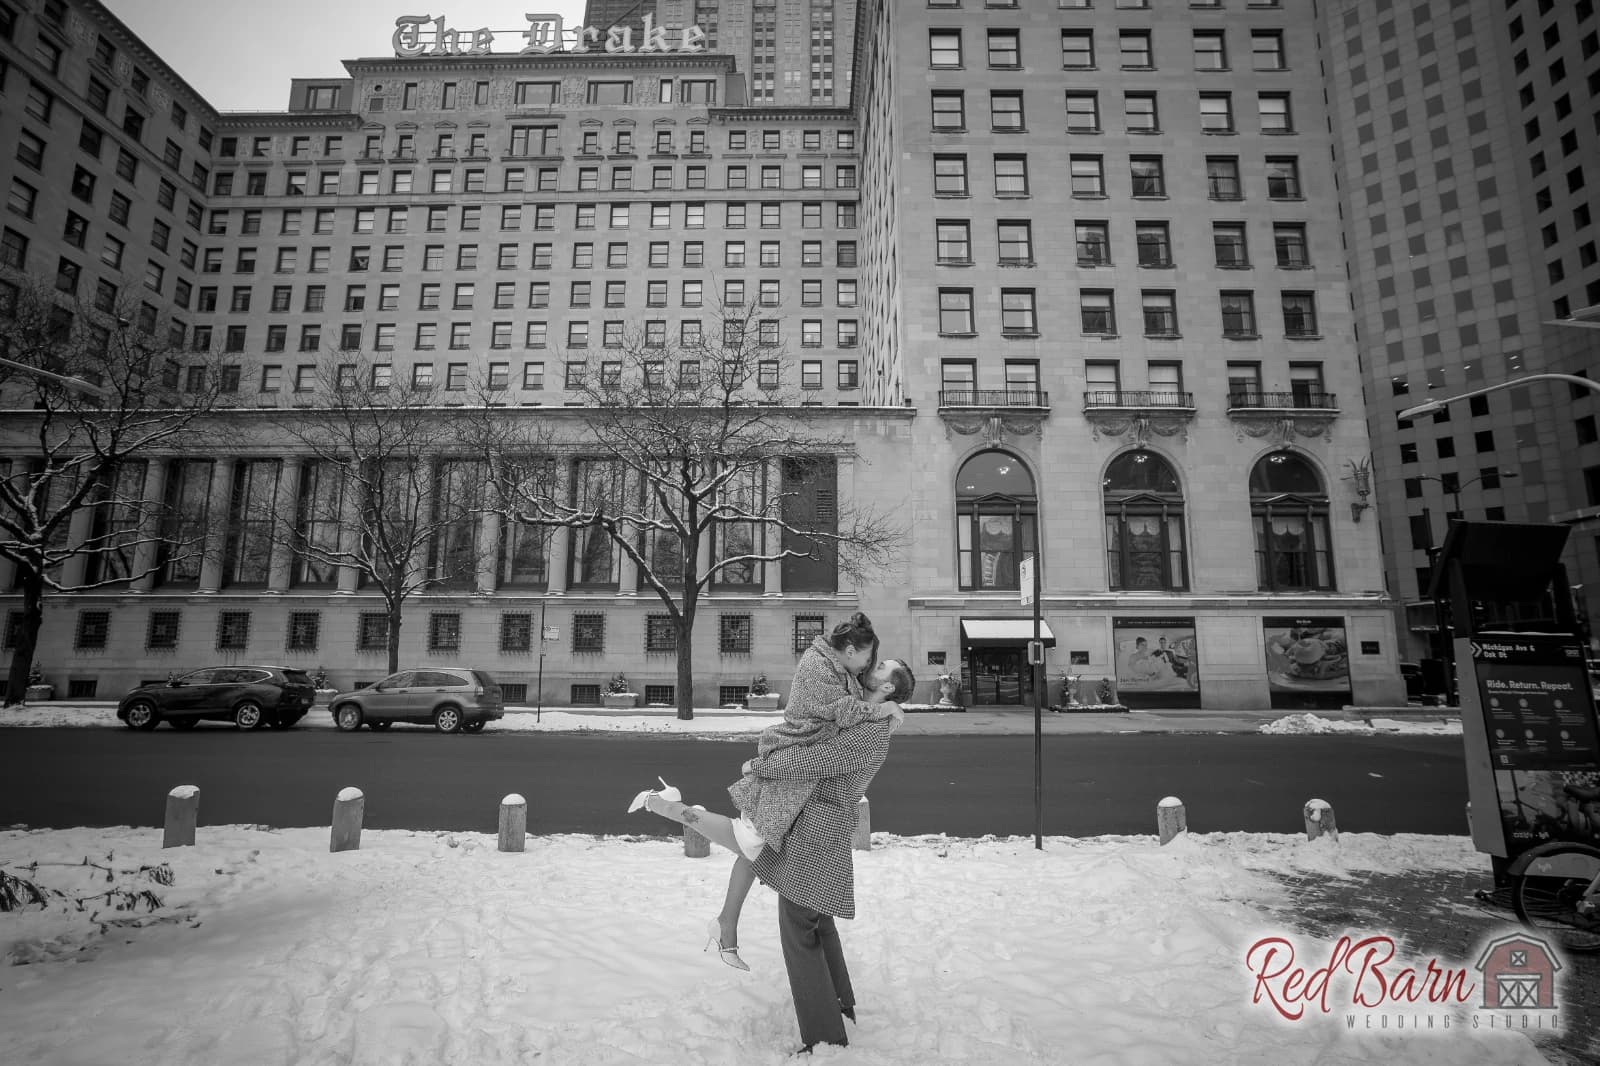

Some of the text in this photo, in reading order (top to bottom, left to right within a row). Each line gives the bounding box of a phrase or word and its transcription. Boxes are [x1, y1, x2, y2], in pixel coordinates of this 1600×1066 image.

[392, 12, 706, 57] The Drake
[1482, 643, 1513, 652] Michigan
[1515, 644, 1528, 652] Ave
[1483, 650, 1497, 658] Oak
[1486, 680, 1509, 689] Ride.
[1509, 680, 1540, 690] Return.
[1540, 681, 1574, 692] Repeat.
